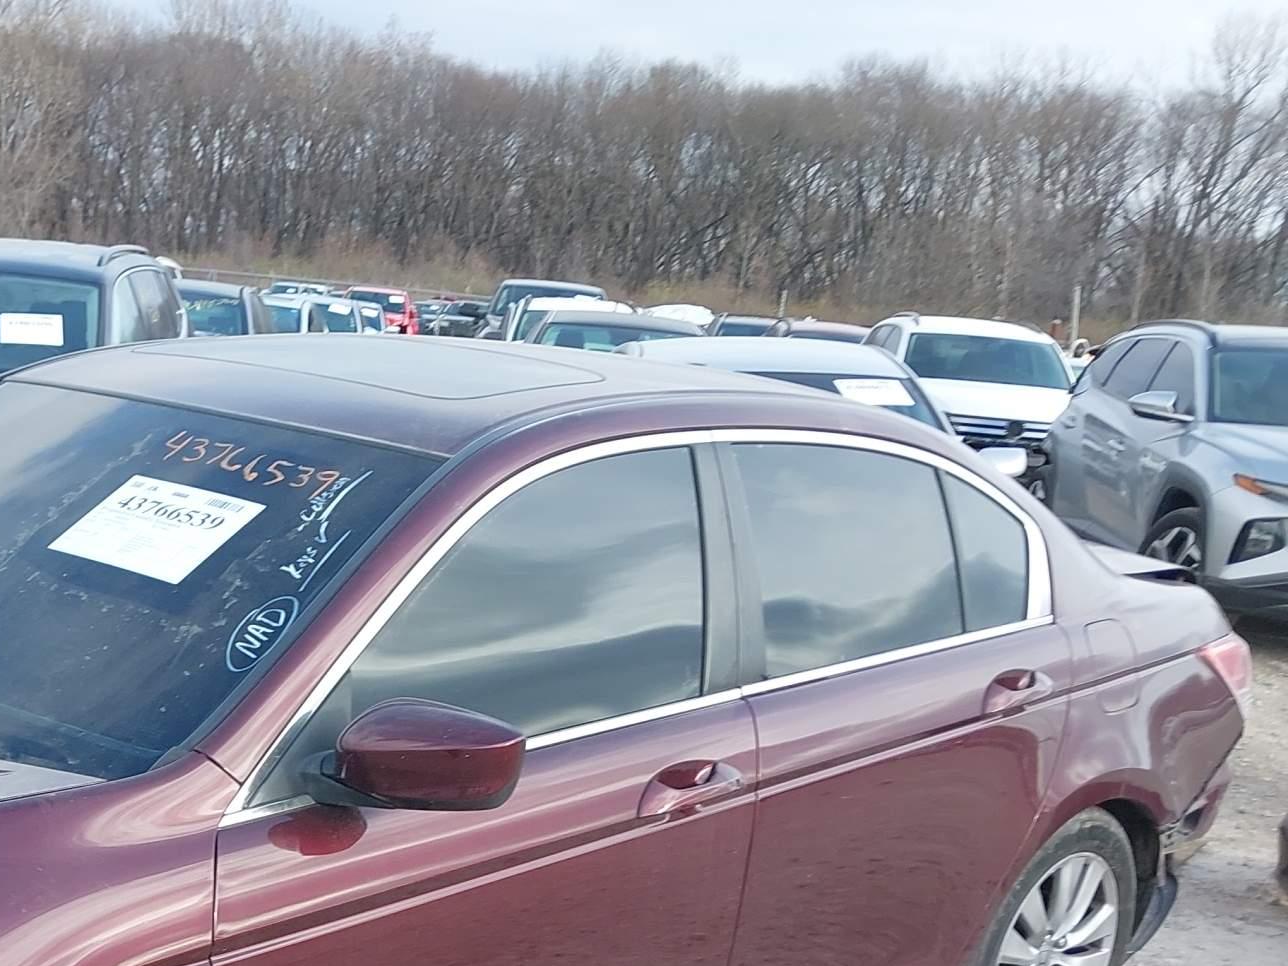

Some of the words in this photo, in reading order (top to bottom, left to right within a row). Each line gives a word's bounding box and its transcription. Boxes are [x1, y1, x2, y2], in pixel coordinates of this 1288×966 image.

[163, 430, 341, 501] 43766539
[117, 495, 226, 530] 43766539
[234, 608, 287, 659] NAD
